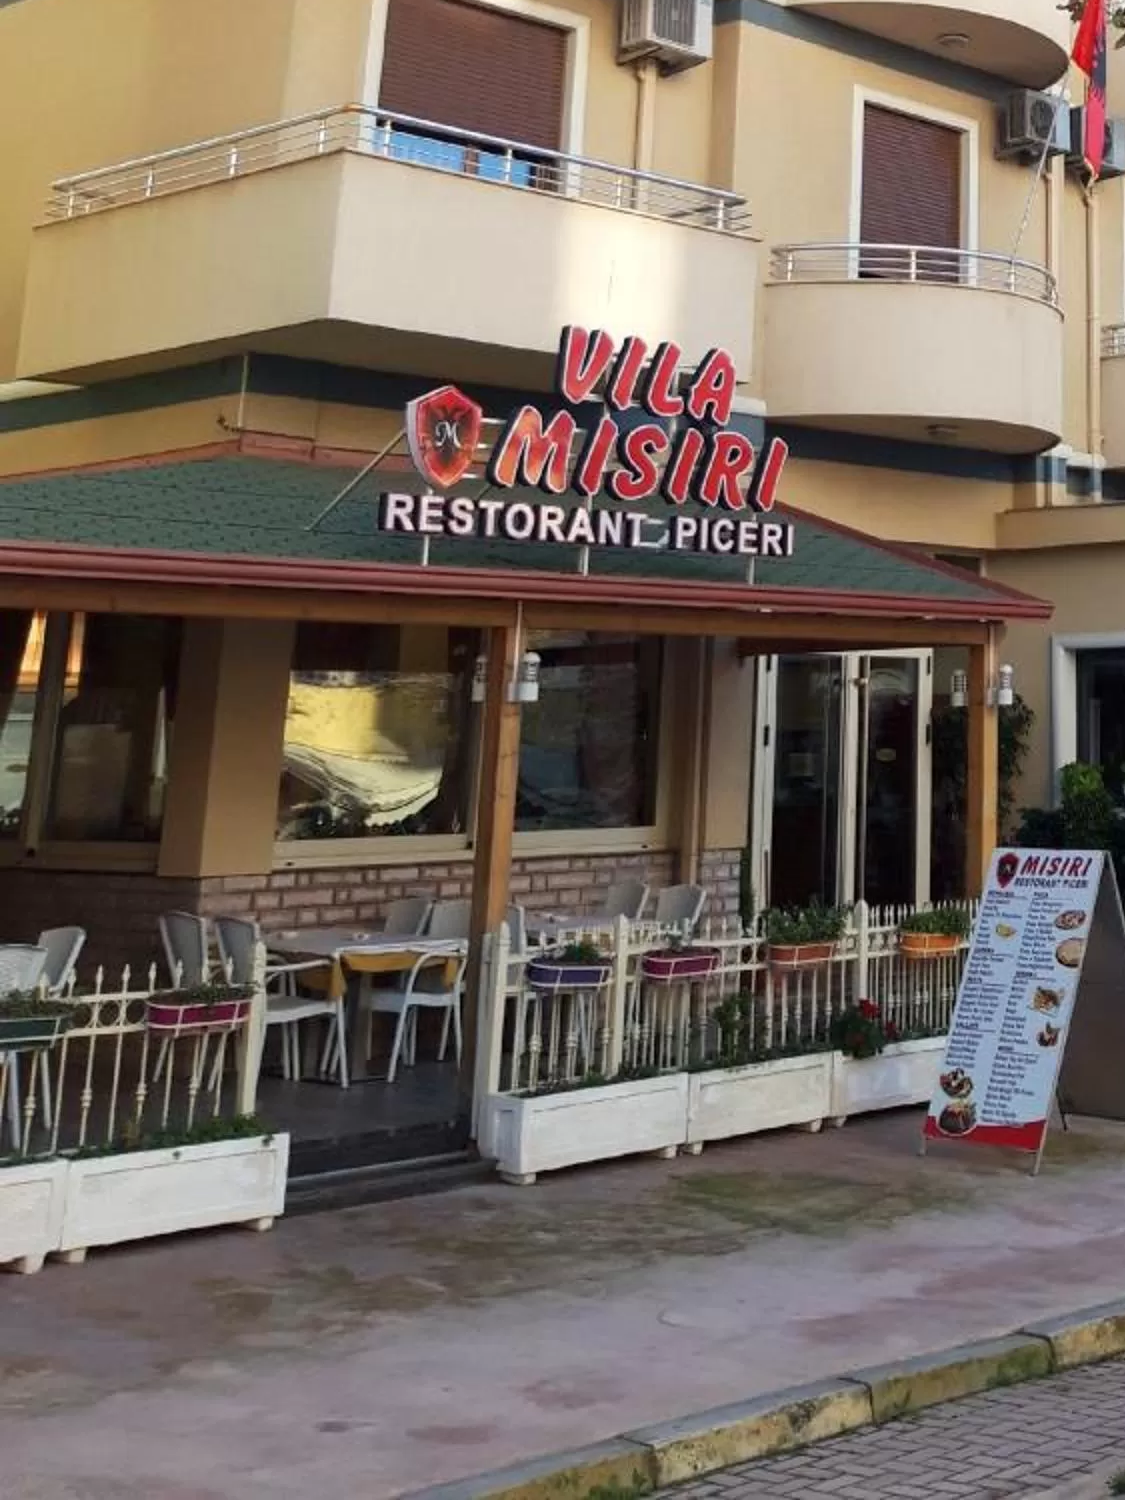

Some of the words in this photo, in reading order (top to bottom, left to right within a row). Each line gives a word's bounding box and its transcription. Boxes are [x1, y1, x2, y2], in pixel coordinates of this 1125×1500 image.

[560, 324, 738, 426] VILA
[490, 406, 789, 512] MISIRI
[383, 493, 645, 548] RESTORANT
[674, 516, 796, 557] PICERI
[1019, 855, 1093, 877] MISIRI
